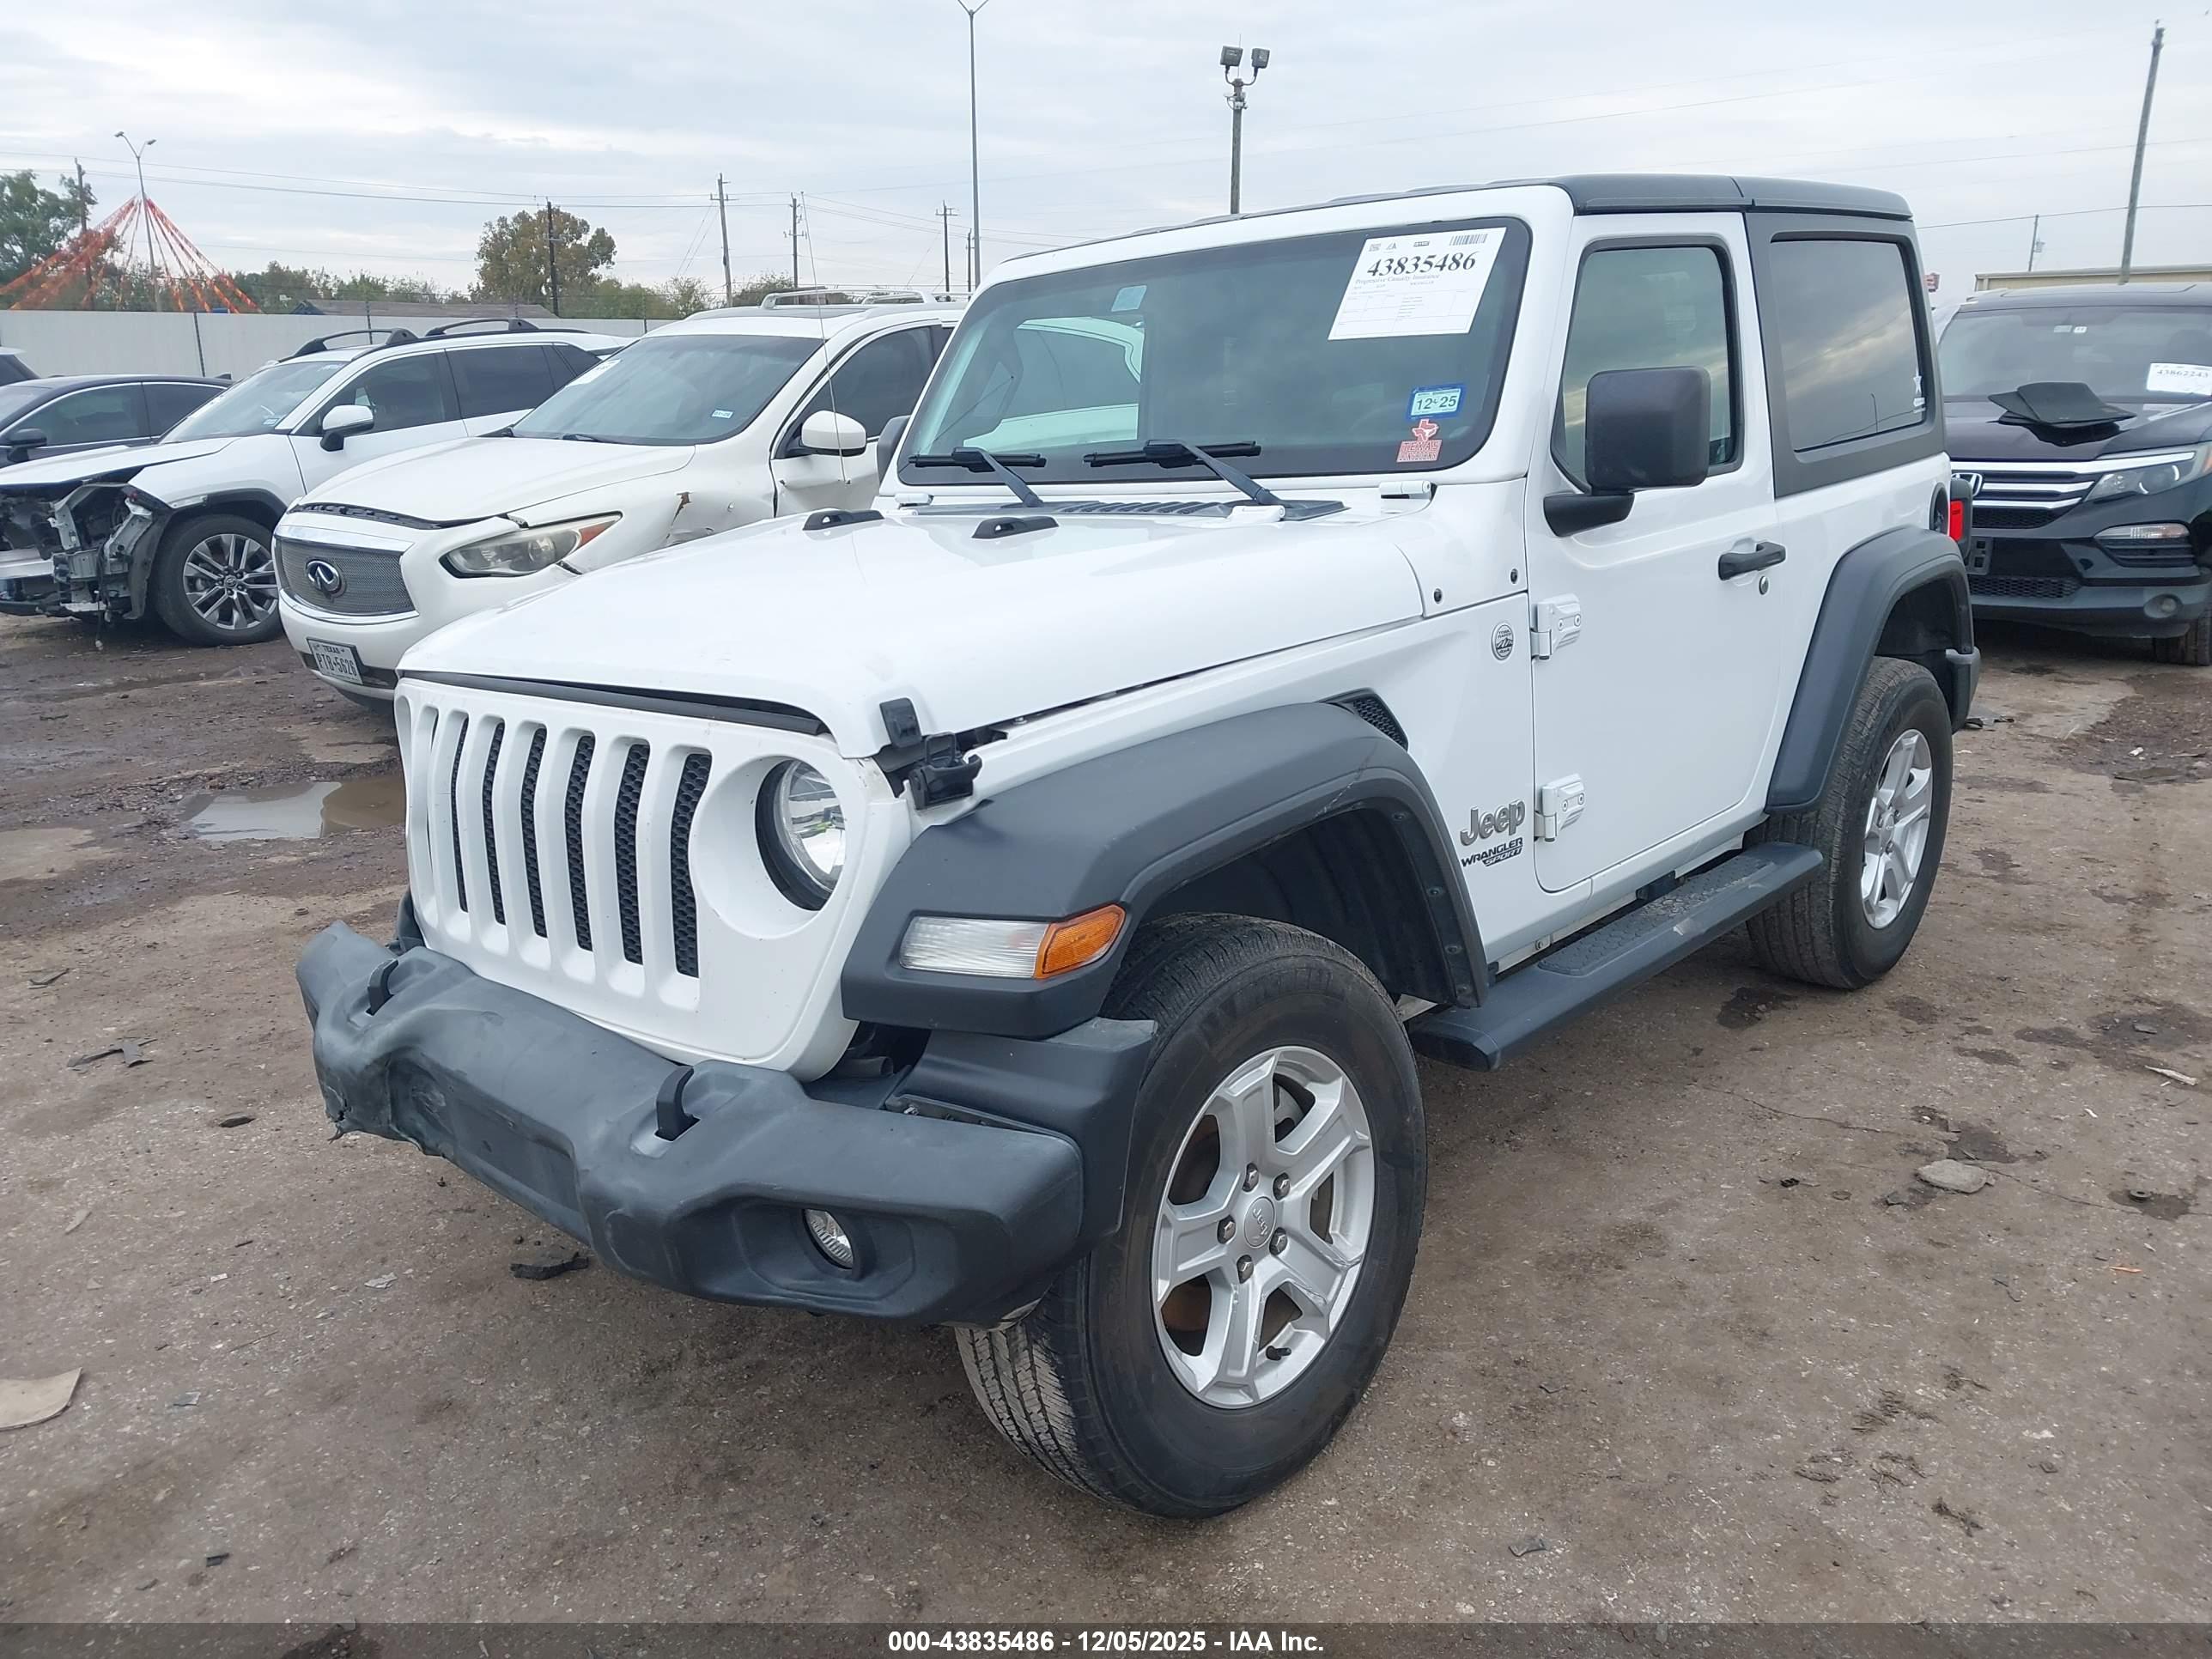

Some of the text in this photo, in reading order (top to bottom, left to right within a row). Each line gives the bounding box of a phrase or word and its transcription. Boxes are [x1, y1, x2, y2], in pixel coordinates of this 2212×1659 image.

[1367, 251, 1480, 276] 43835486
[1417, 396, 1457, 410] 12 25
[1402, 441, 1438, 452] TEXAS
[1460, 799, 1526, 846] Jeep
[1461, 836, 1523, 867] WRANGLER
[1484, 848, 1522, 866] SPORT
